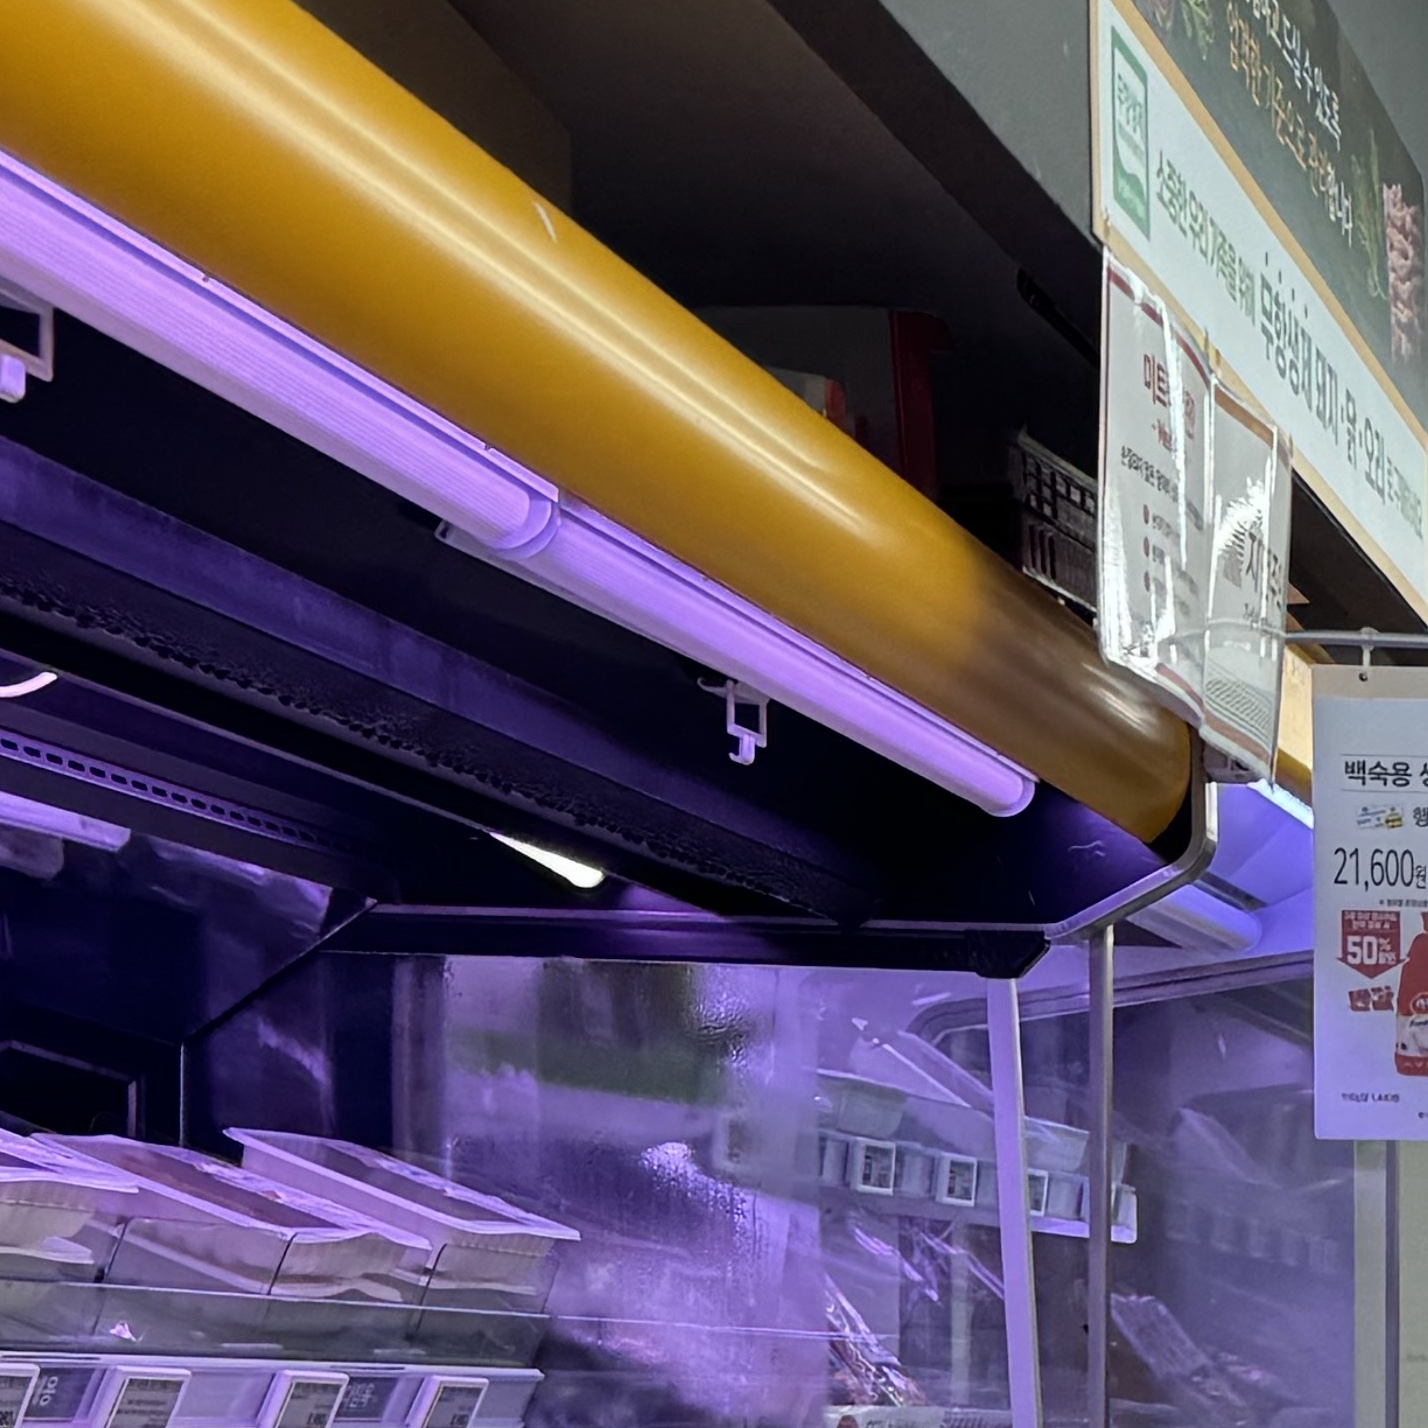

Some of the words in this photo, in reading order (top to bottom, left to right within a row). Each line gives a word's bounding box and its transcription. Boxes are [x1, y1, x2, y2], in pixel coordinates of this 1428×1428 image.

[1261, 271, 1313, 413] 무항생제
[1345, 760, 1412, 788] 백숙용
[1334, 847, 1428, 892] 21,600원
